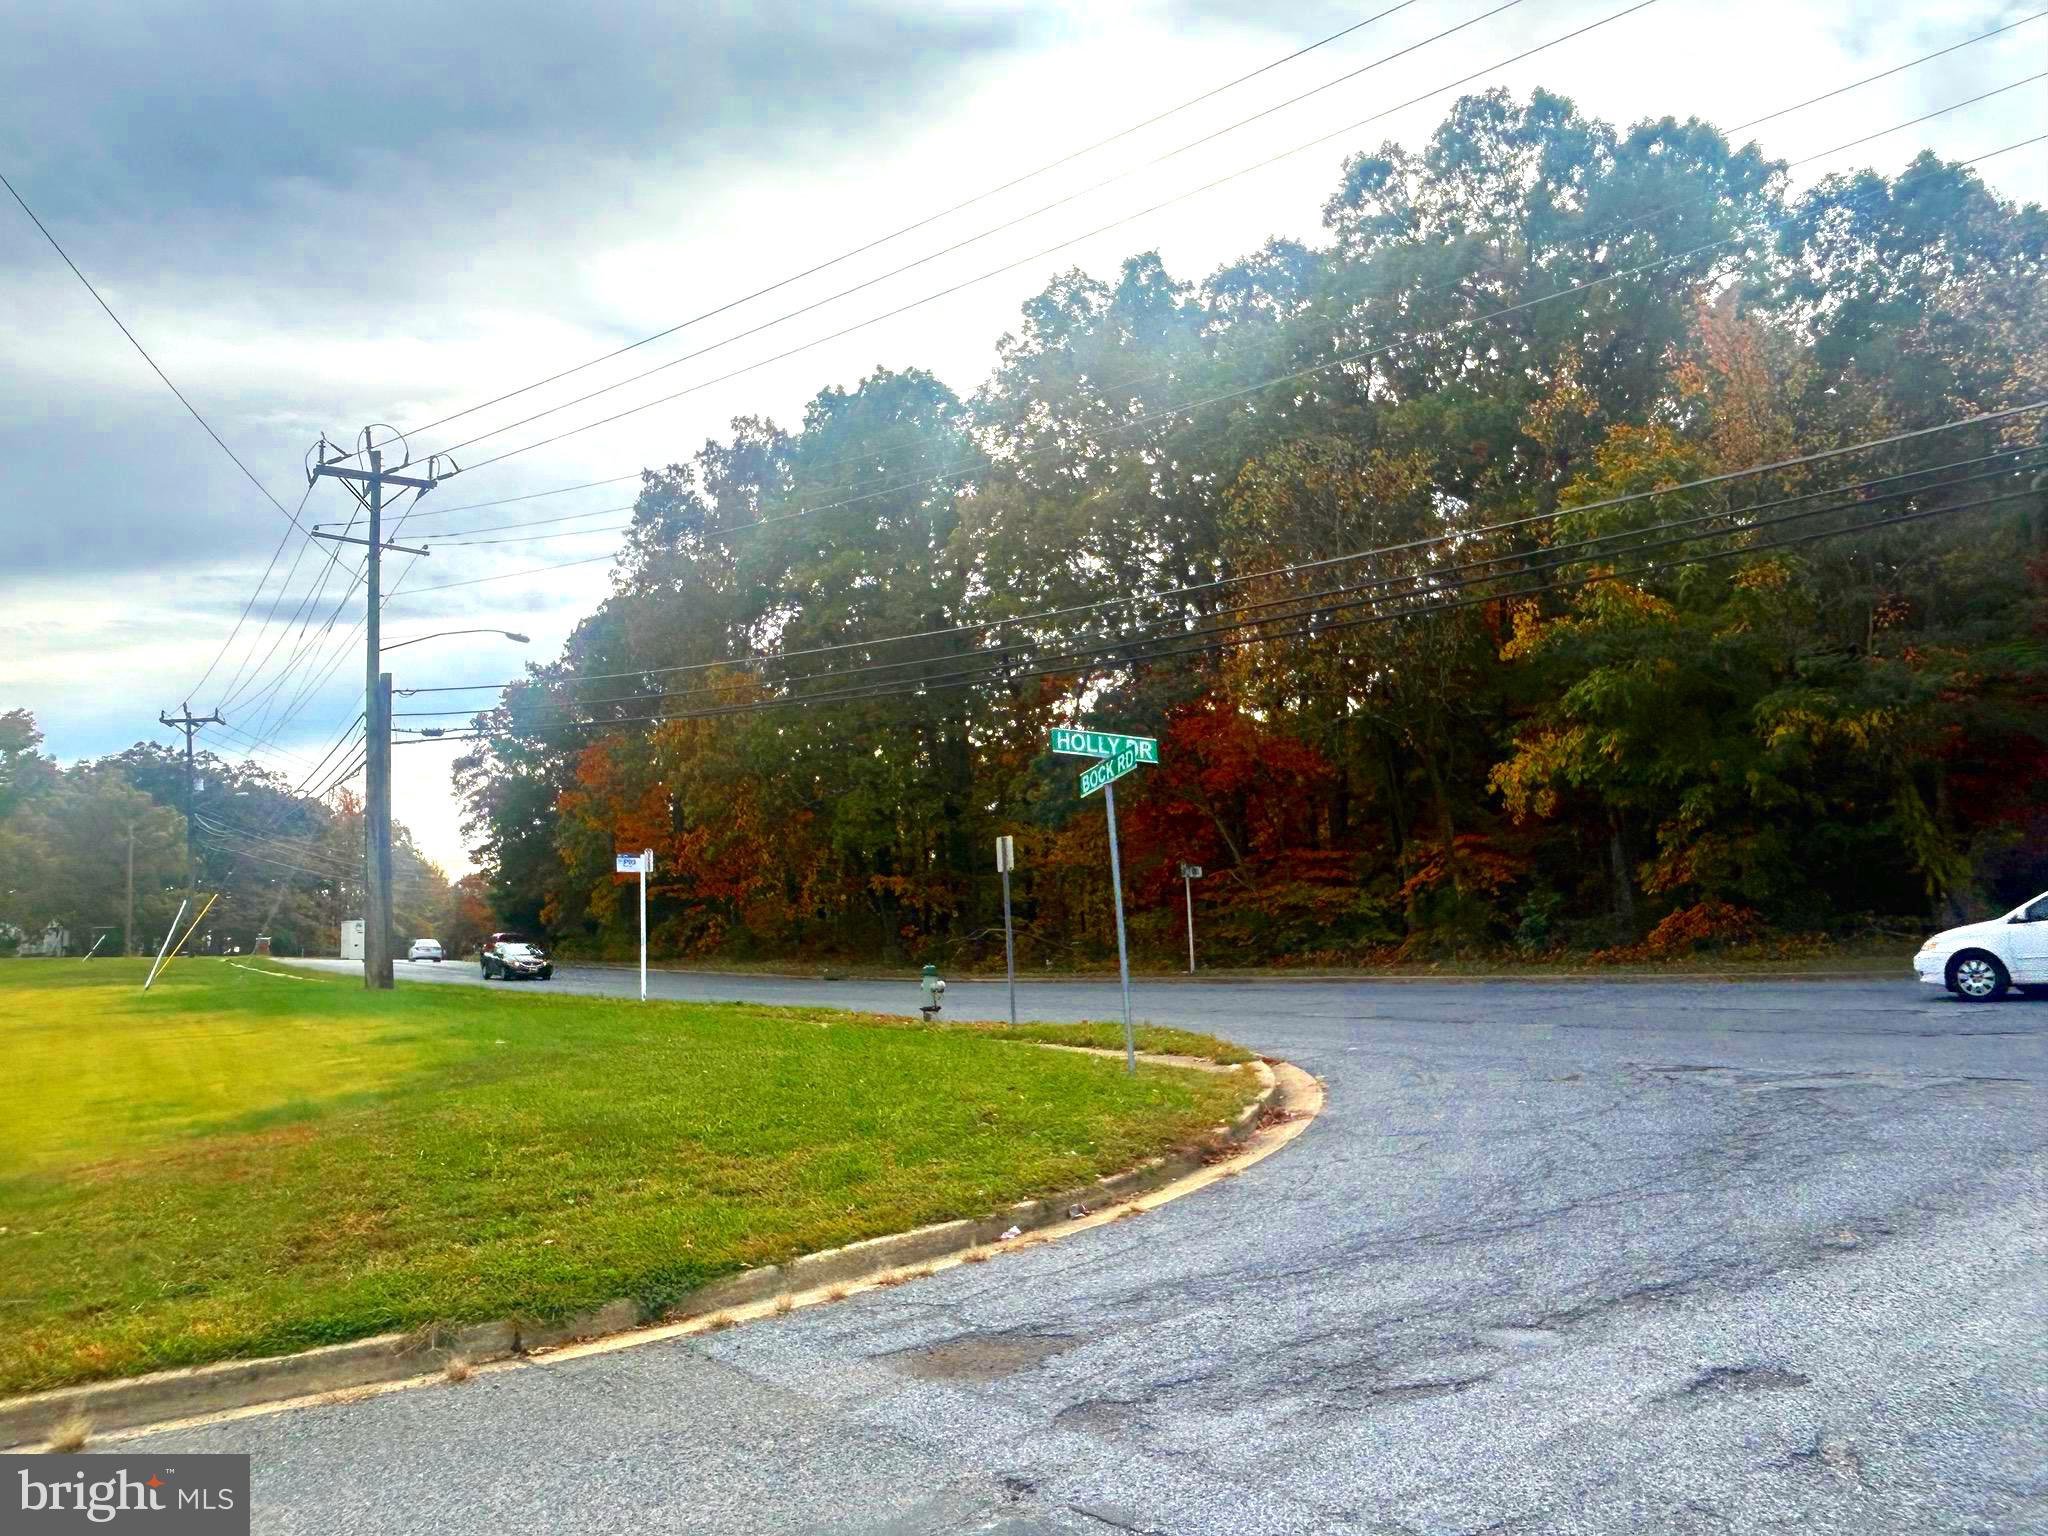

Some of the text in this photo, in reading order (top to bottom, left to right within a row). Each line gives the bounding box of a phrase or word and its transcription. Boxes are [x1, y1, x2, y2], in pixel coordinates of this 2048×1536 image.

[1057, 731, 1153, 760] HOLLY DR
[1081, 749, 1134, 793] BOCK RD
